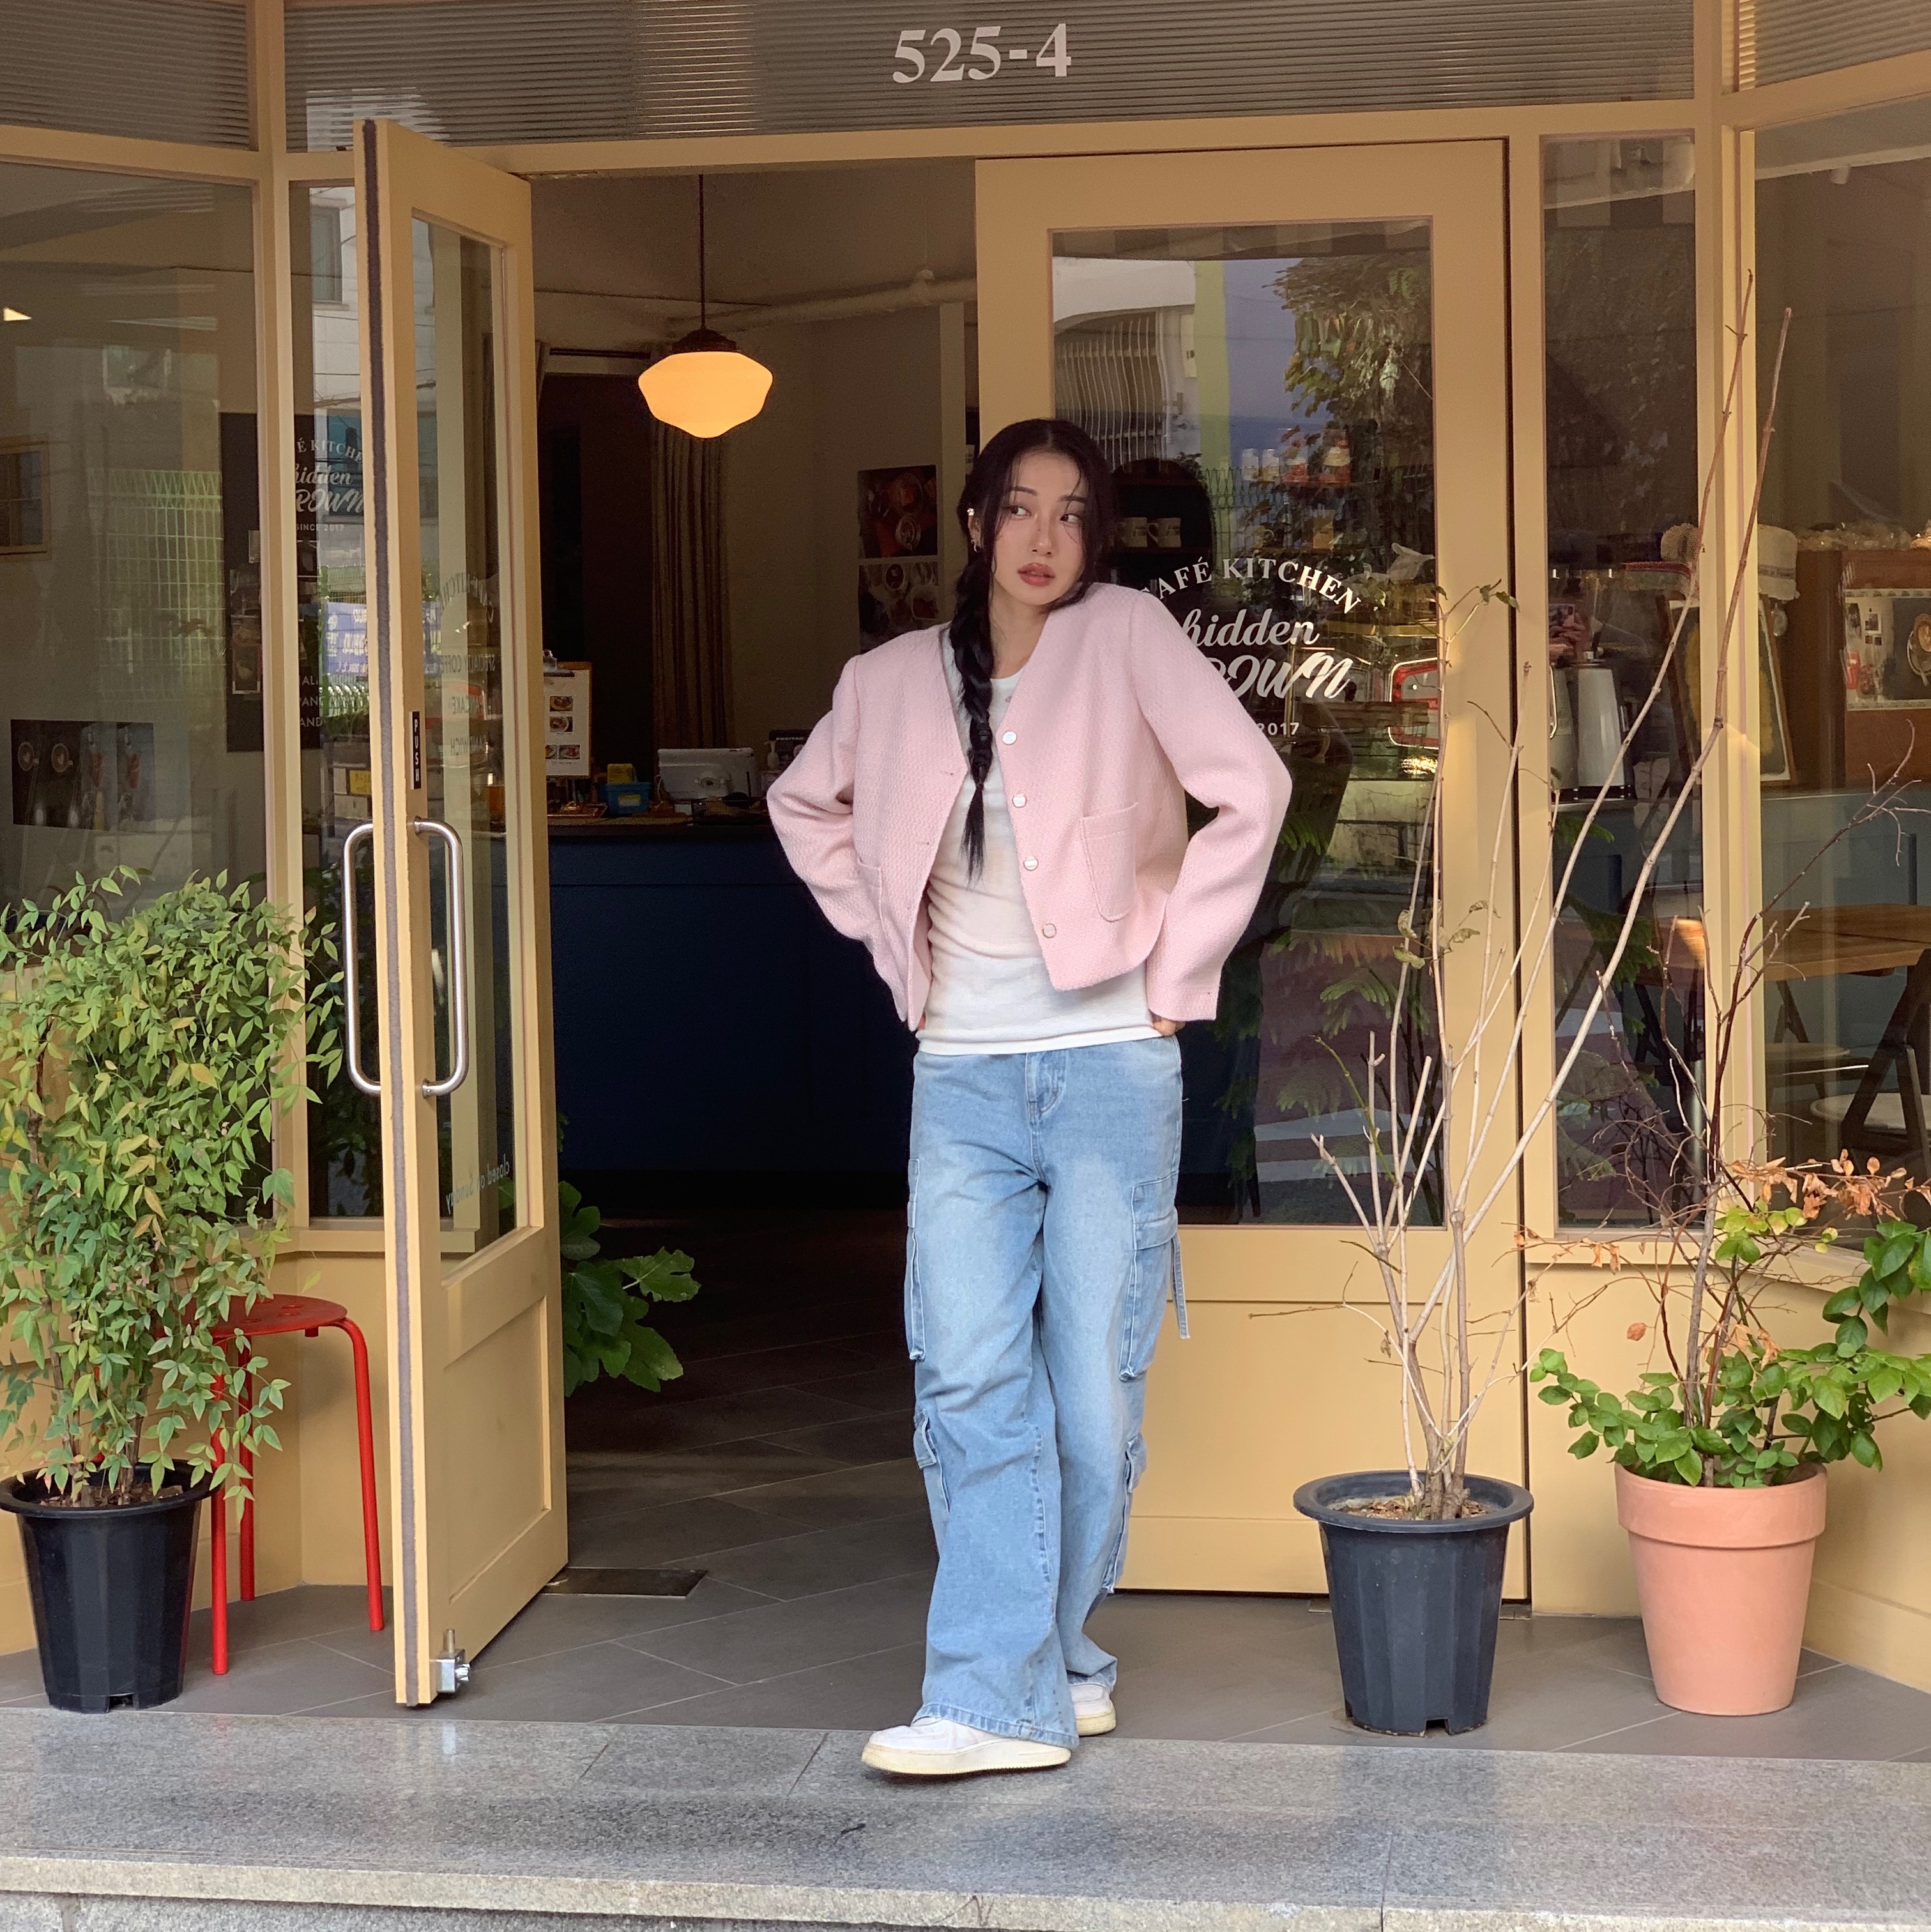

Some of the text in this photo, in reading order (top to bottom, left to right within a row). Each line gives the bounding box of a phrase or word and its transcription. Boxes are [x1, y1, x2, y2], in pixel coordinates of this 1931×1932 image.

[892, 23, 1072, 83] 525-4
[324, 523, 344, 531] 2017
[1140, 556, 1362, 614] AFÉ KITCHEN
[1182, 608, 1320, 646] hidden
